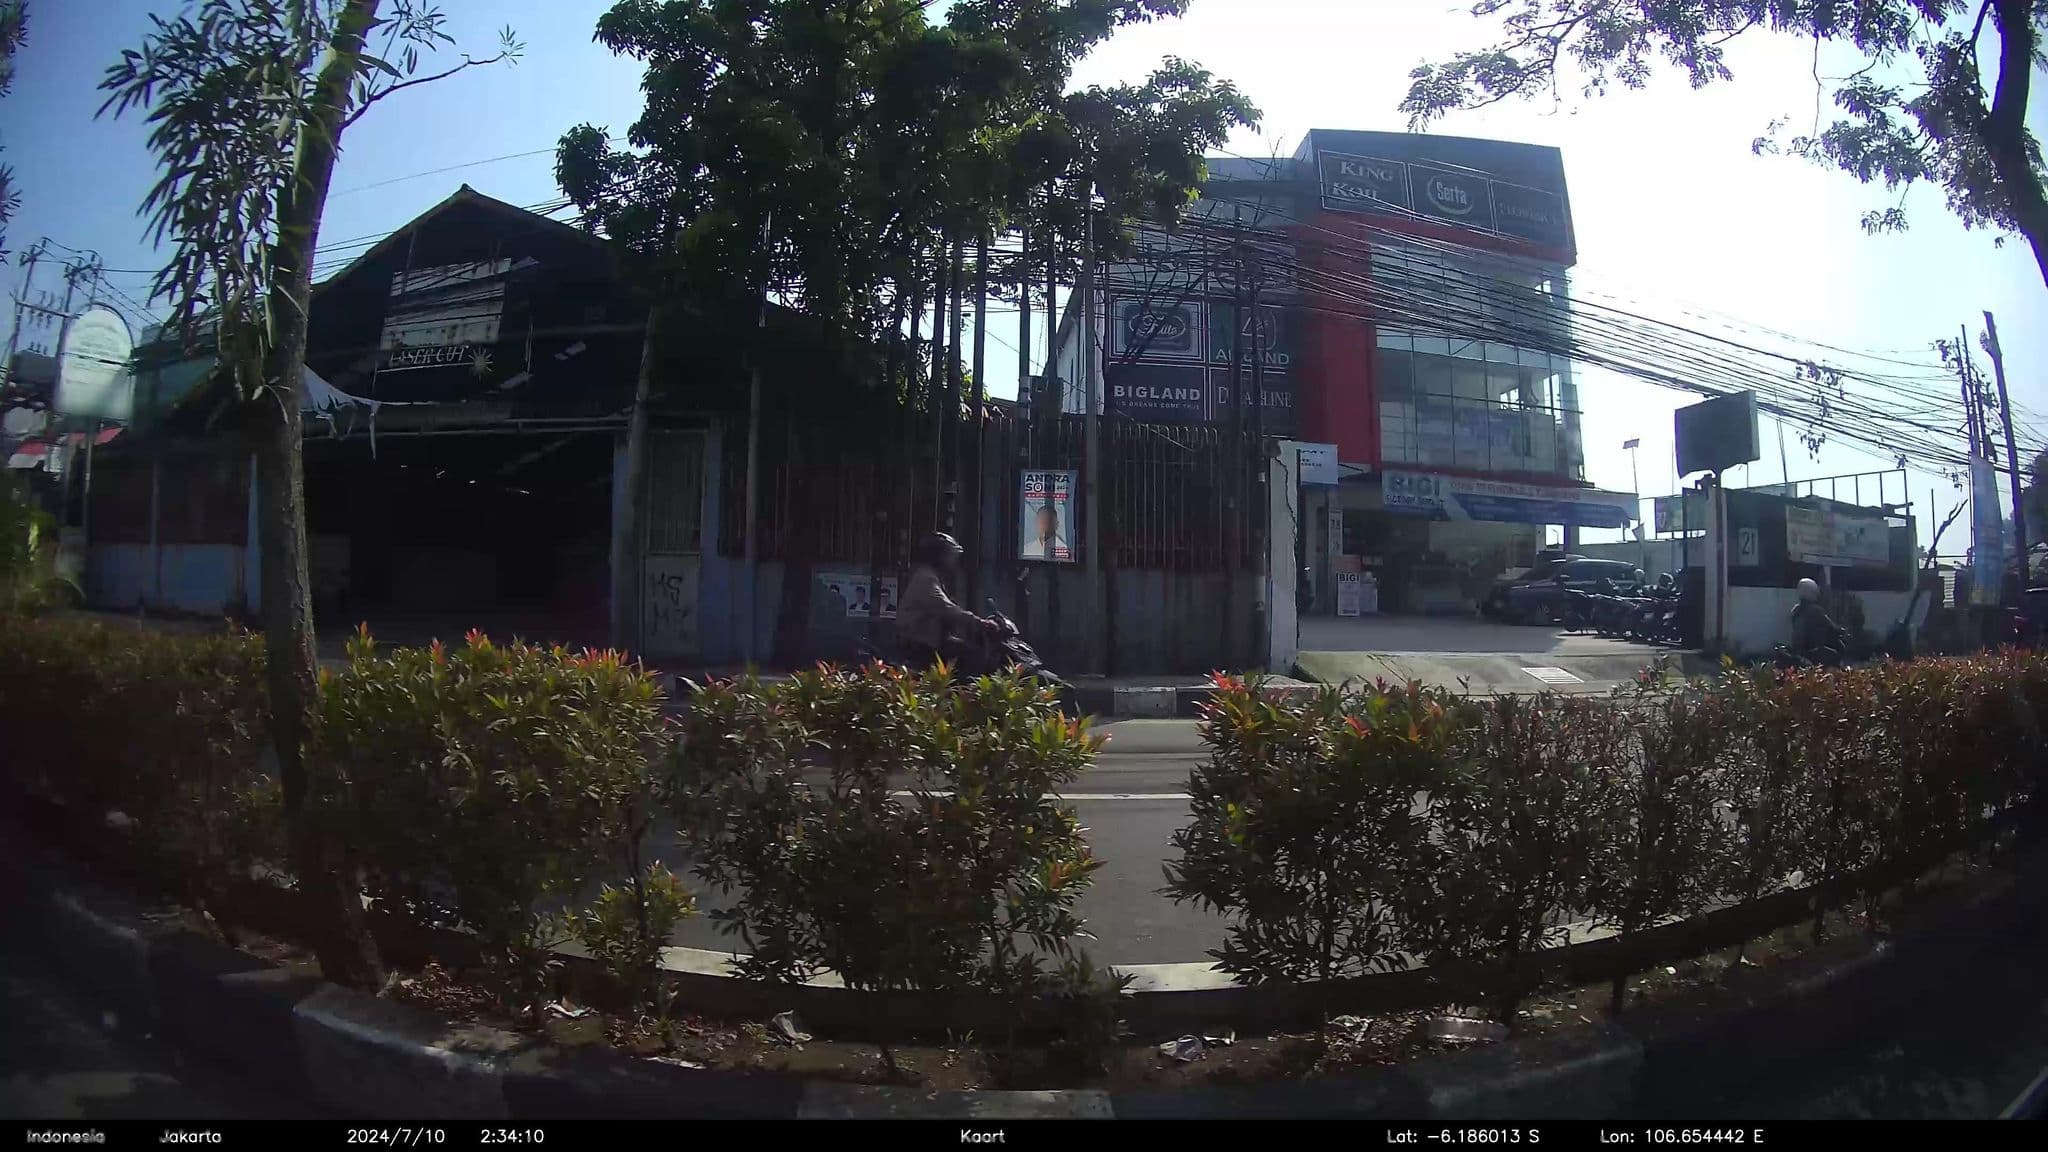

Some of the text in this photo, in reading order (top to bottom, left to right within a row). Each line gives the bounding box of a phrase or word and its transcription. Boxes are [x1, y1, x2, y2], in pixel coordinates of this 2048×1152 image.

[1341, 161, 1393, 182] KING
[1436, 181, 1467, 205] Serta
[436, 346, 468, 362] CUT
[1114, 385, 1200, 401] BIGLAND
